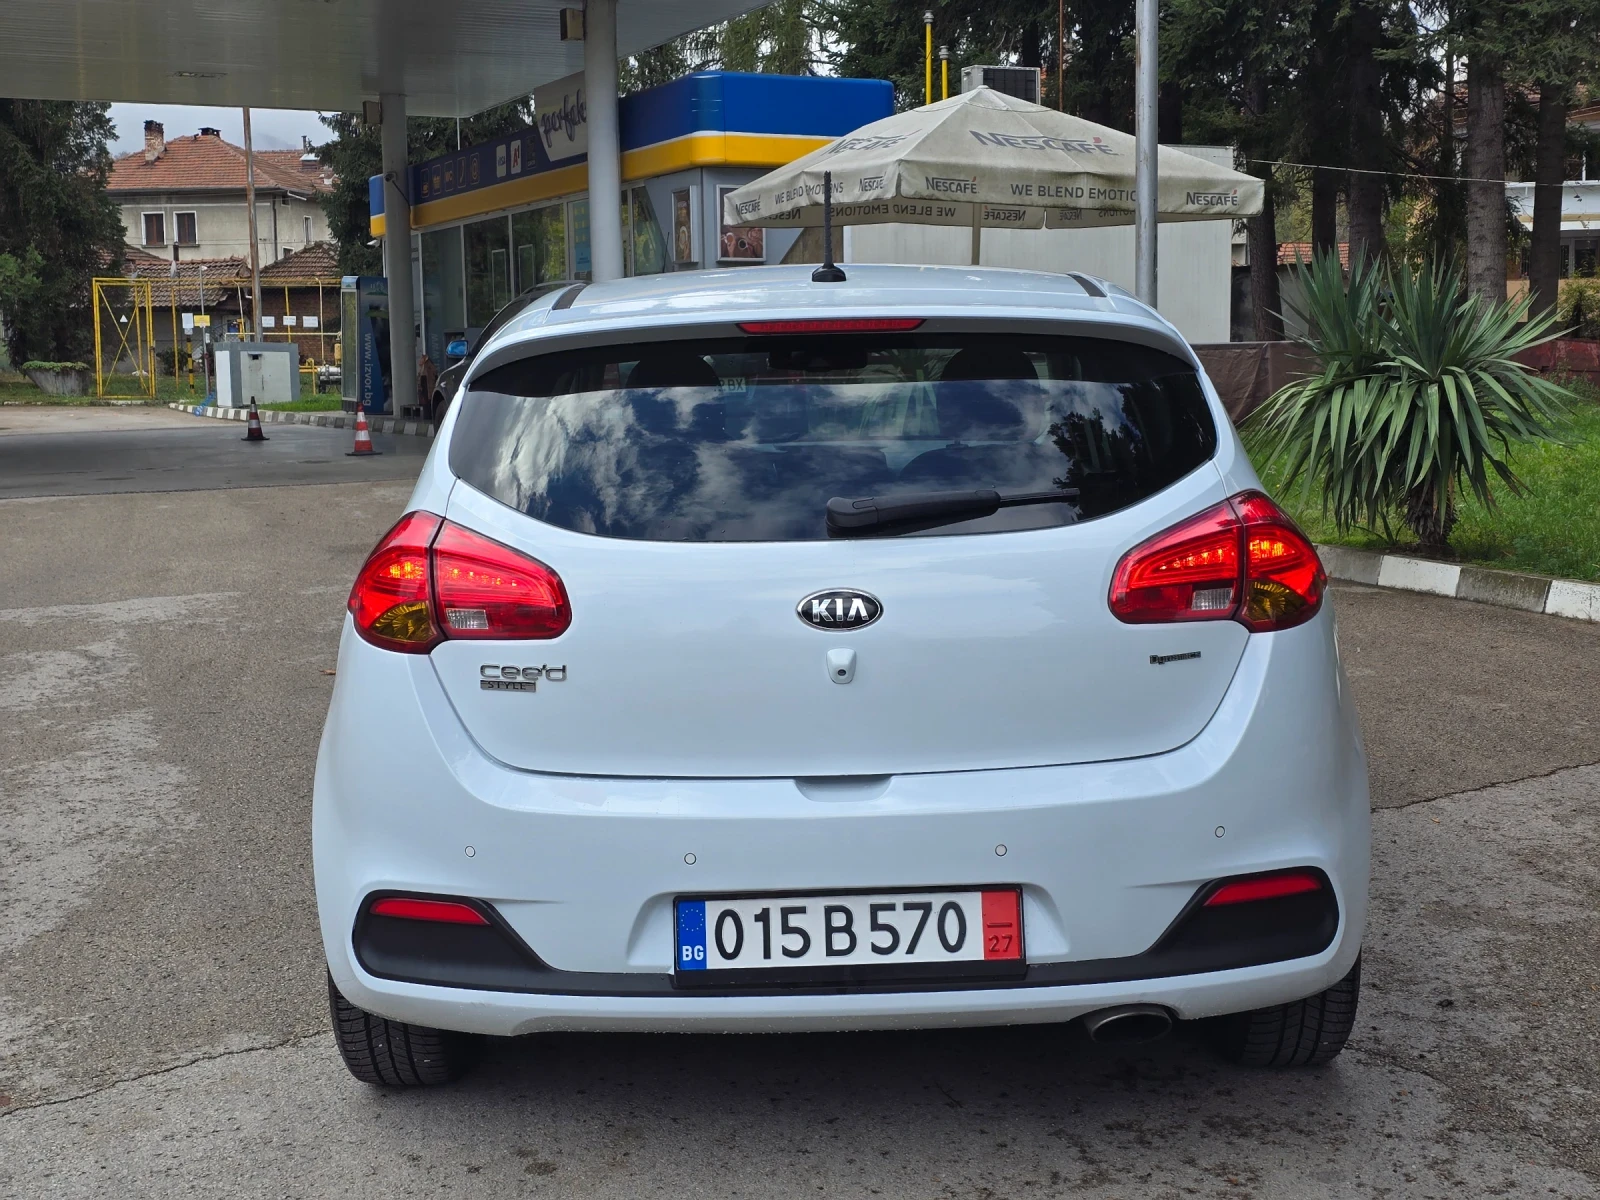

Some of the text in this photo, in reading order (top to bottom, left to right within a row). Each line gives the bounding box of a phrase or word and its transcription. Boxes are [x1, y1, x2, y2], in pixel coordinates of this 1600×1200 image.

[541, 88, 587, 148] perfek
[969, 129, 1120, 156] NESCAFÉ
[512, 144, 520, 168] A1
[925, 176, 978, 194] NESCAFÉ
[1010, 183, 1137, 202] WE BLEND EMOTIO
[735, 194, 761, 215] NESCAFÉ
[774, 193, 785, 205] WE
[1186, 189, 1238, 206] NESCAFÉ
[363, 333, 373, 406] www.izvor.bg
[811, 598, 869, 622] KIA
[487, 681, 526, 691] STYLE
[682, 945, 704, 961] BG
[988, 934, 1013, 953] 27
